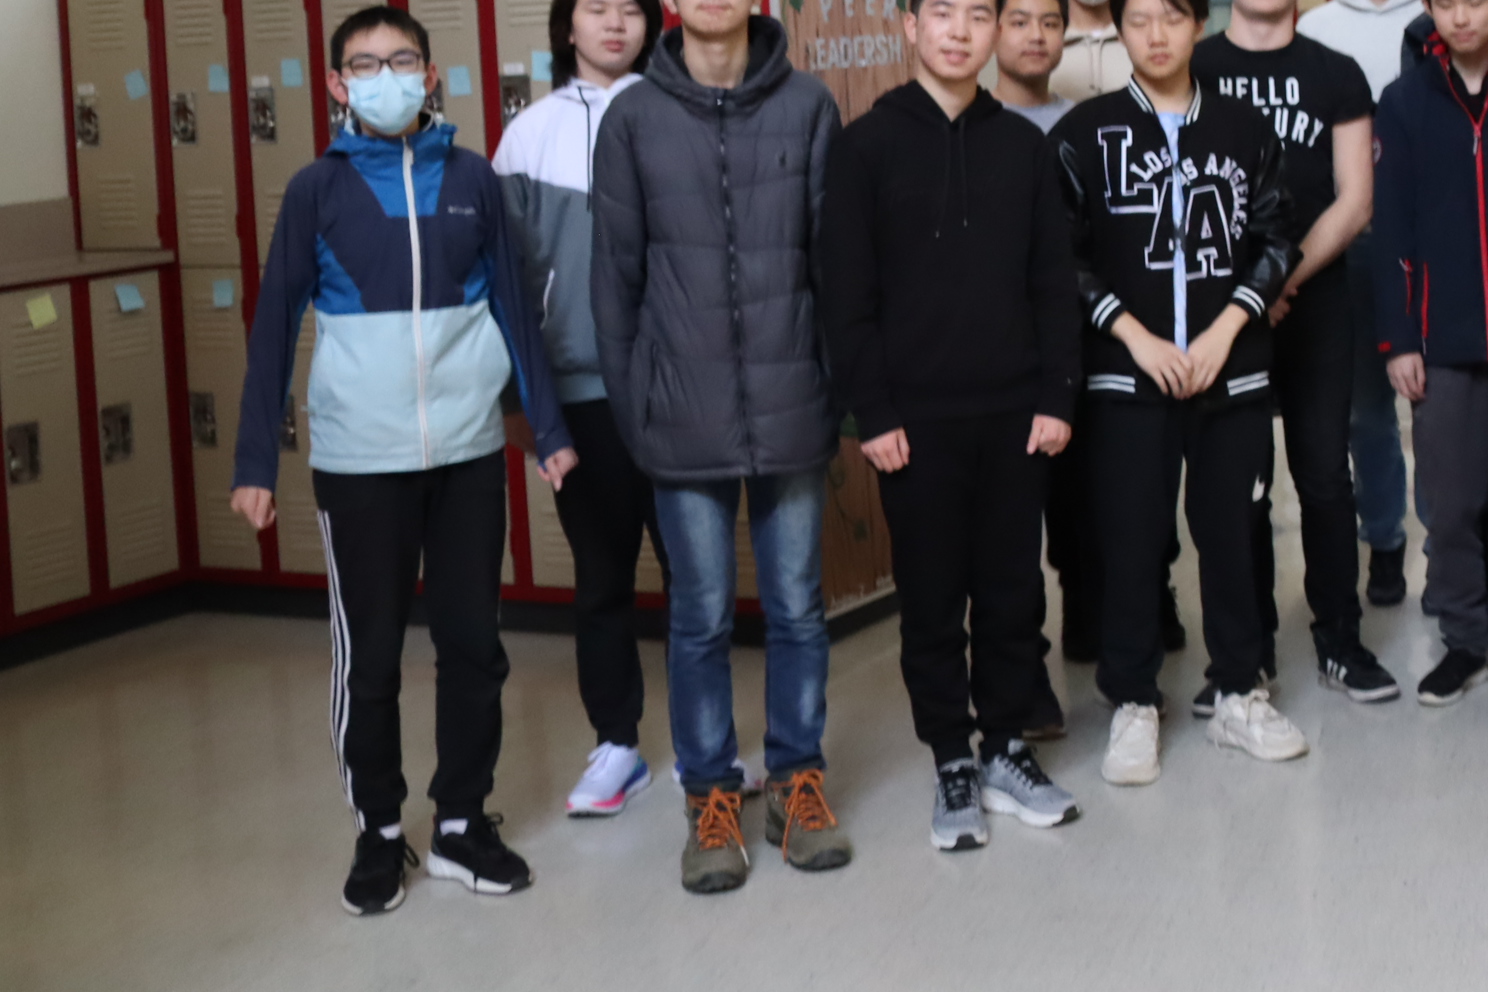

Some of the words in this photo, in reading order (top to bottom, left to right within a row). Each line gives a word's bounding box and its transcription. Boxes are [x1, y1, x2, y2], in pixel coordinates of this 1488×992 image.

[1219, 76, 1300, 106] HELLO
[1262, 107, 1324, 148] URY
[1204, 152, 1249, 241] ANGELES
